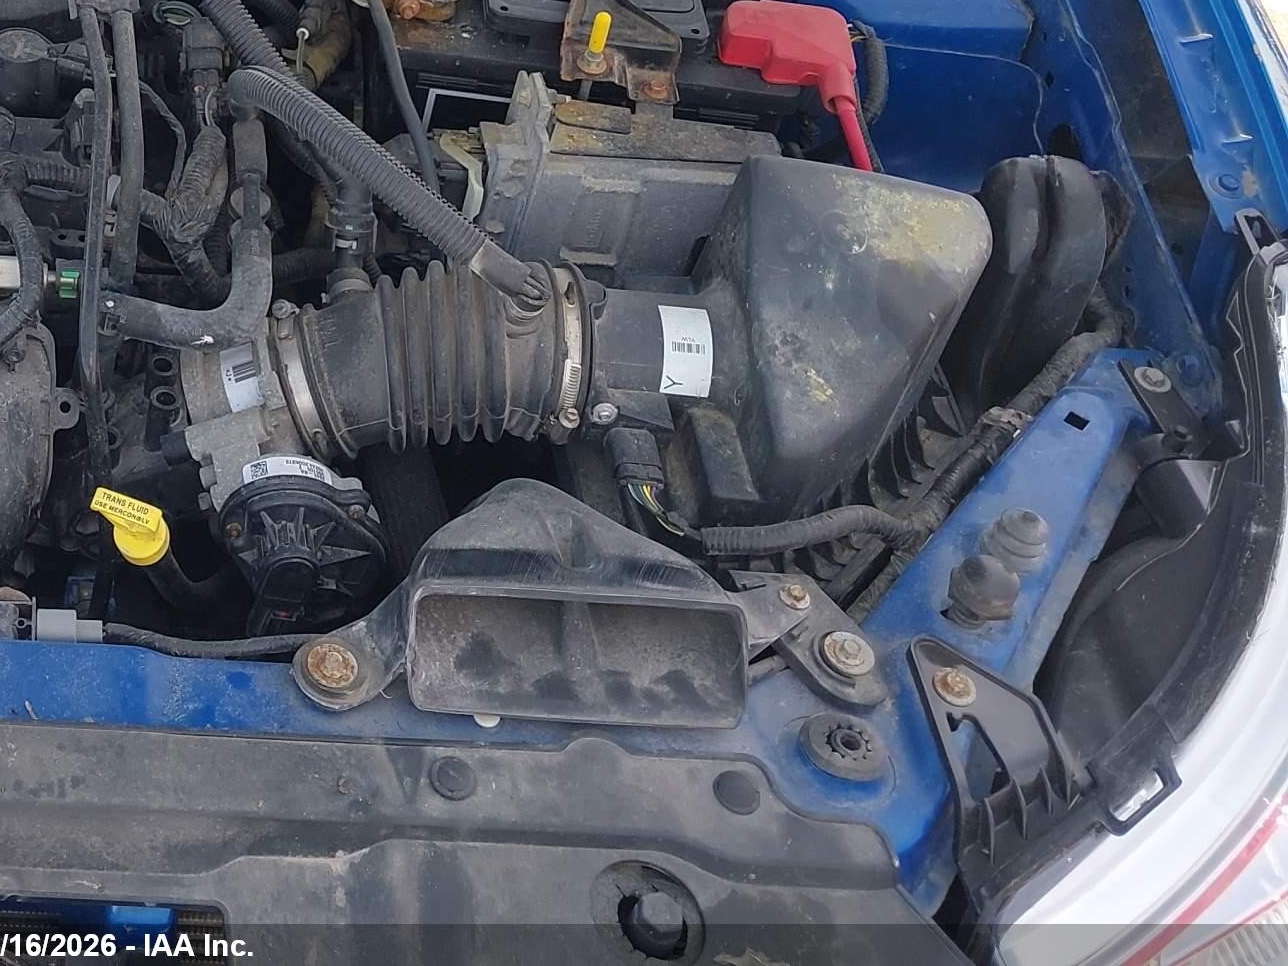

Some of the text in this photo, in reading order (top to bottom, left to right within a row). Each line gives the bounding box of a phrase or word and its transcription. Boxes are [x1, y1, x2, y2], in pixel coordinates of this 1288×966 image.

[663, 375, 683, 389] Y
[94, 499, 108, 509] USE
[102, 492, 149, 515] TRANS FLUID
